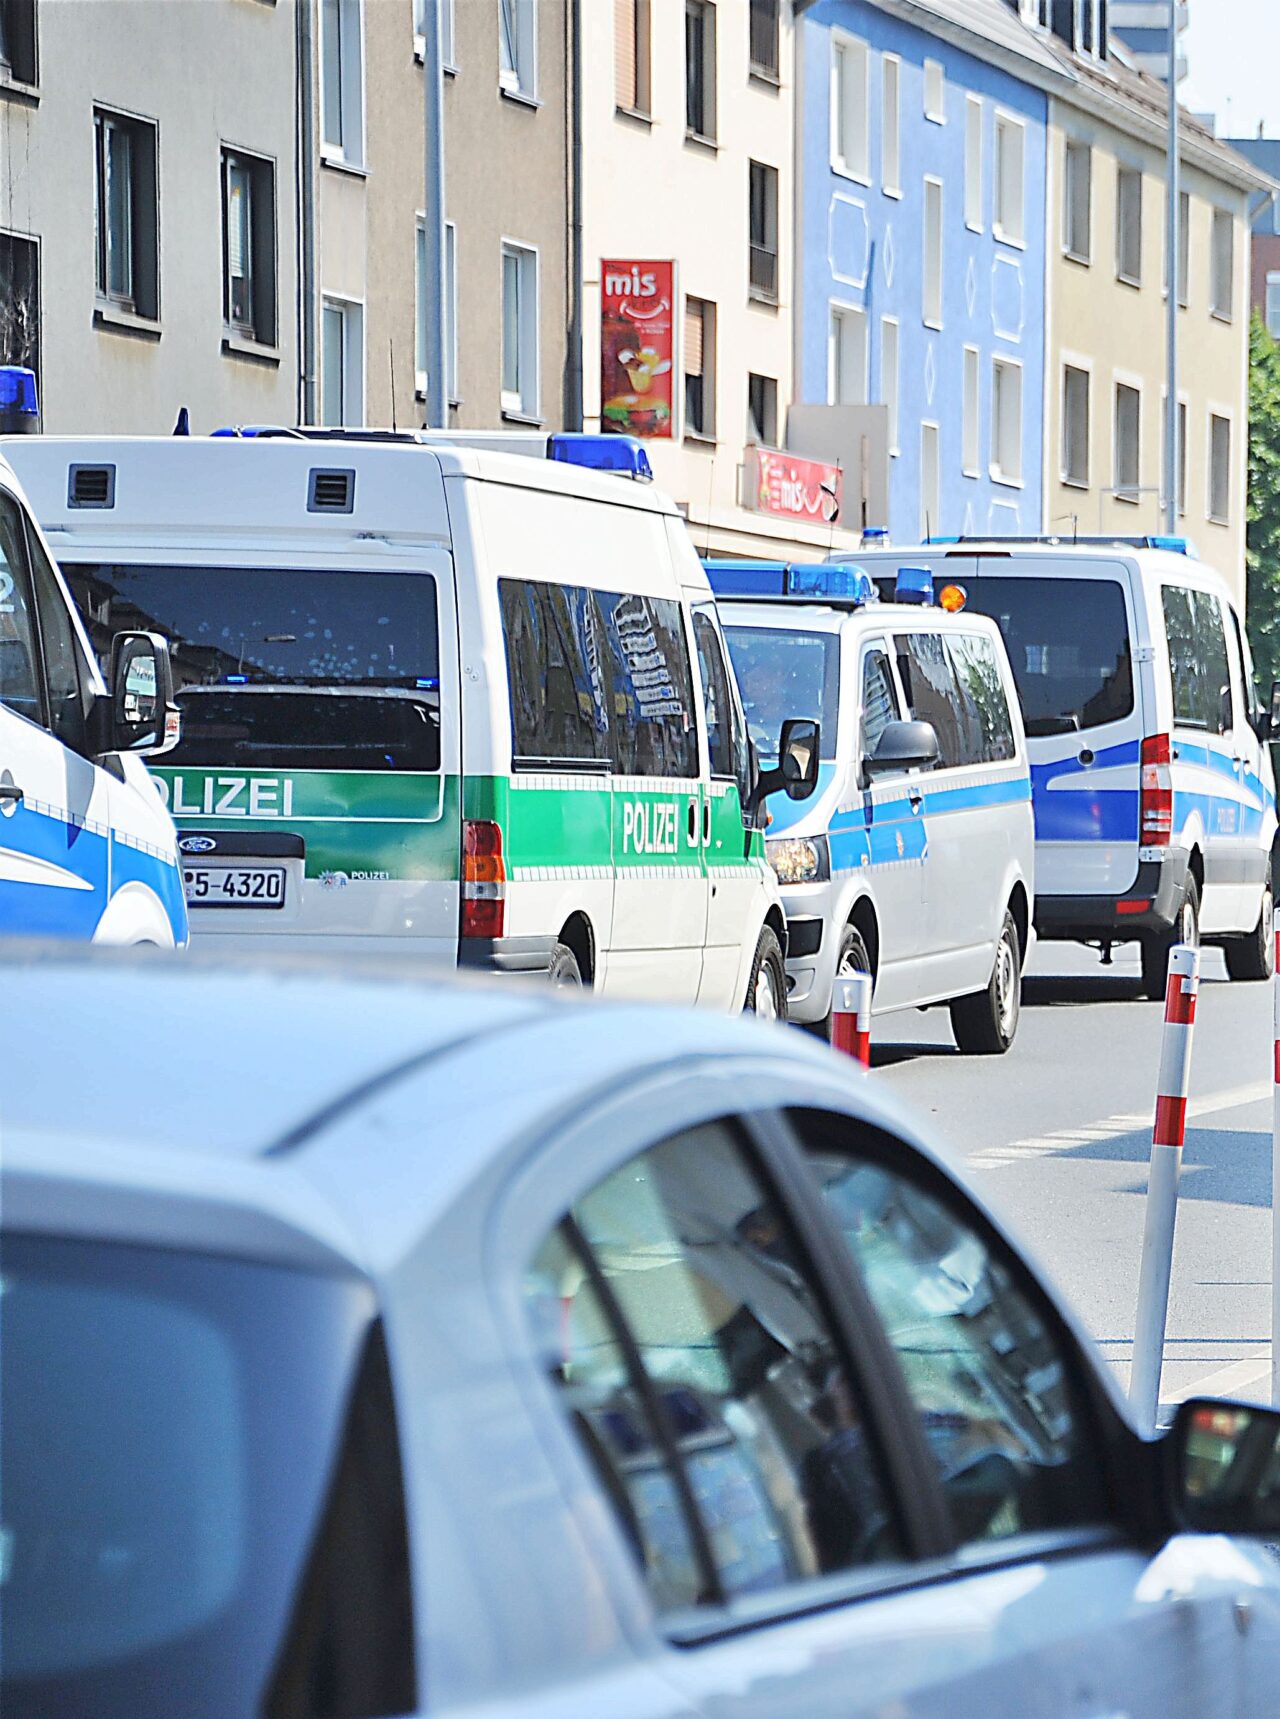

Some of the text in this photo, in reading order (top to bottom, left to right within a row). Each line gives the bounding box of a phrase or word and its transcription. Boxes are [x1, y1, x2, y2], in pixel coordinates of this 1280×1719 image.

[605, 265, 657, 297] mis
[623, 801, 678, 854] POLIZEI
[351, 871, 390, 880] POLIZEI
